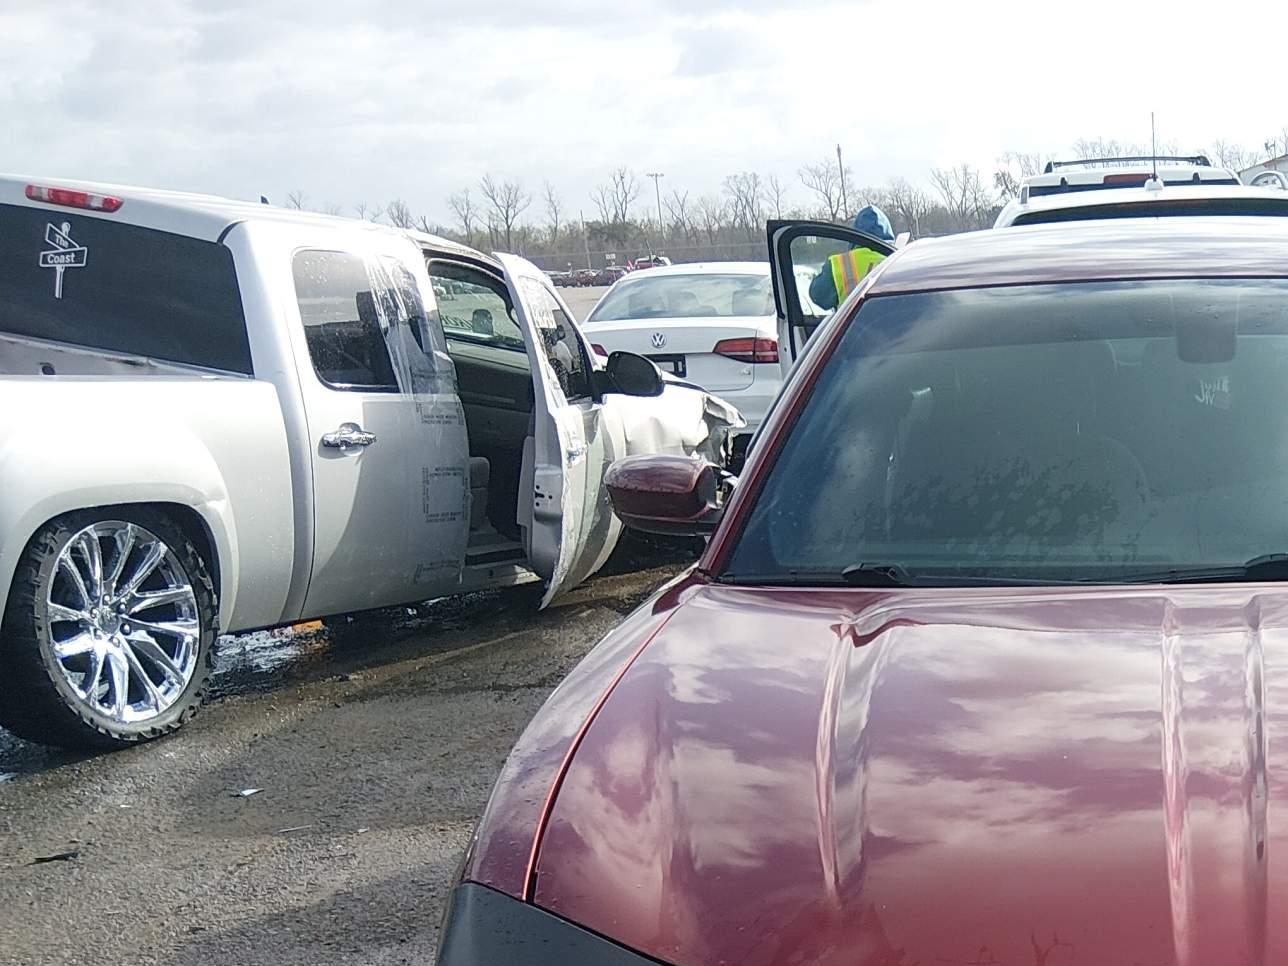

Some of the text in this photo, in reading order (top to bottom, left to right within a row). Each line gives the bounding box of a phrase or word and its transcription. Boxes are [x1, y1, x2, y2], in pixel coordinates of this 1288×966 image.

[54, 233, 69, 248] The
[47, 252, 75, 264] Coast
[650, 331, 666, 348] VW
